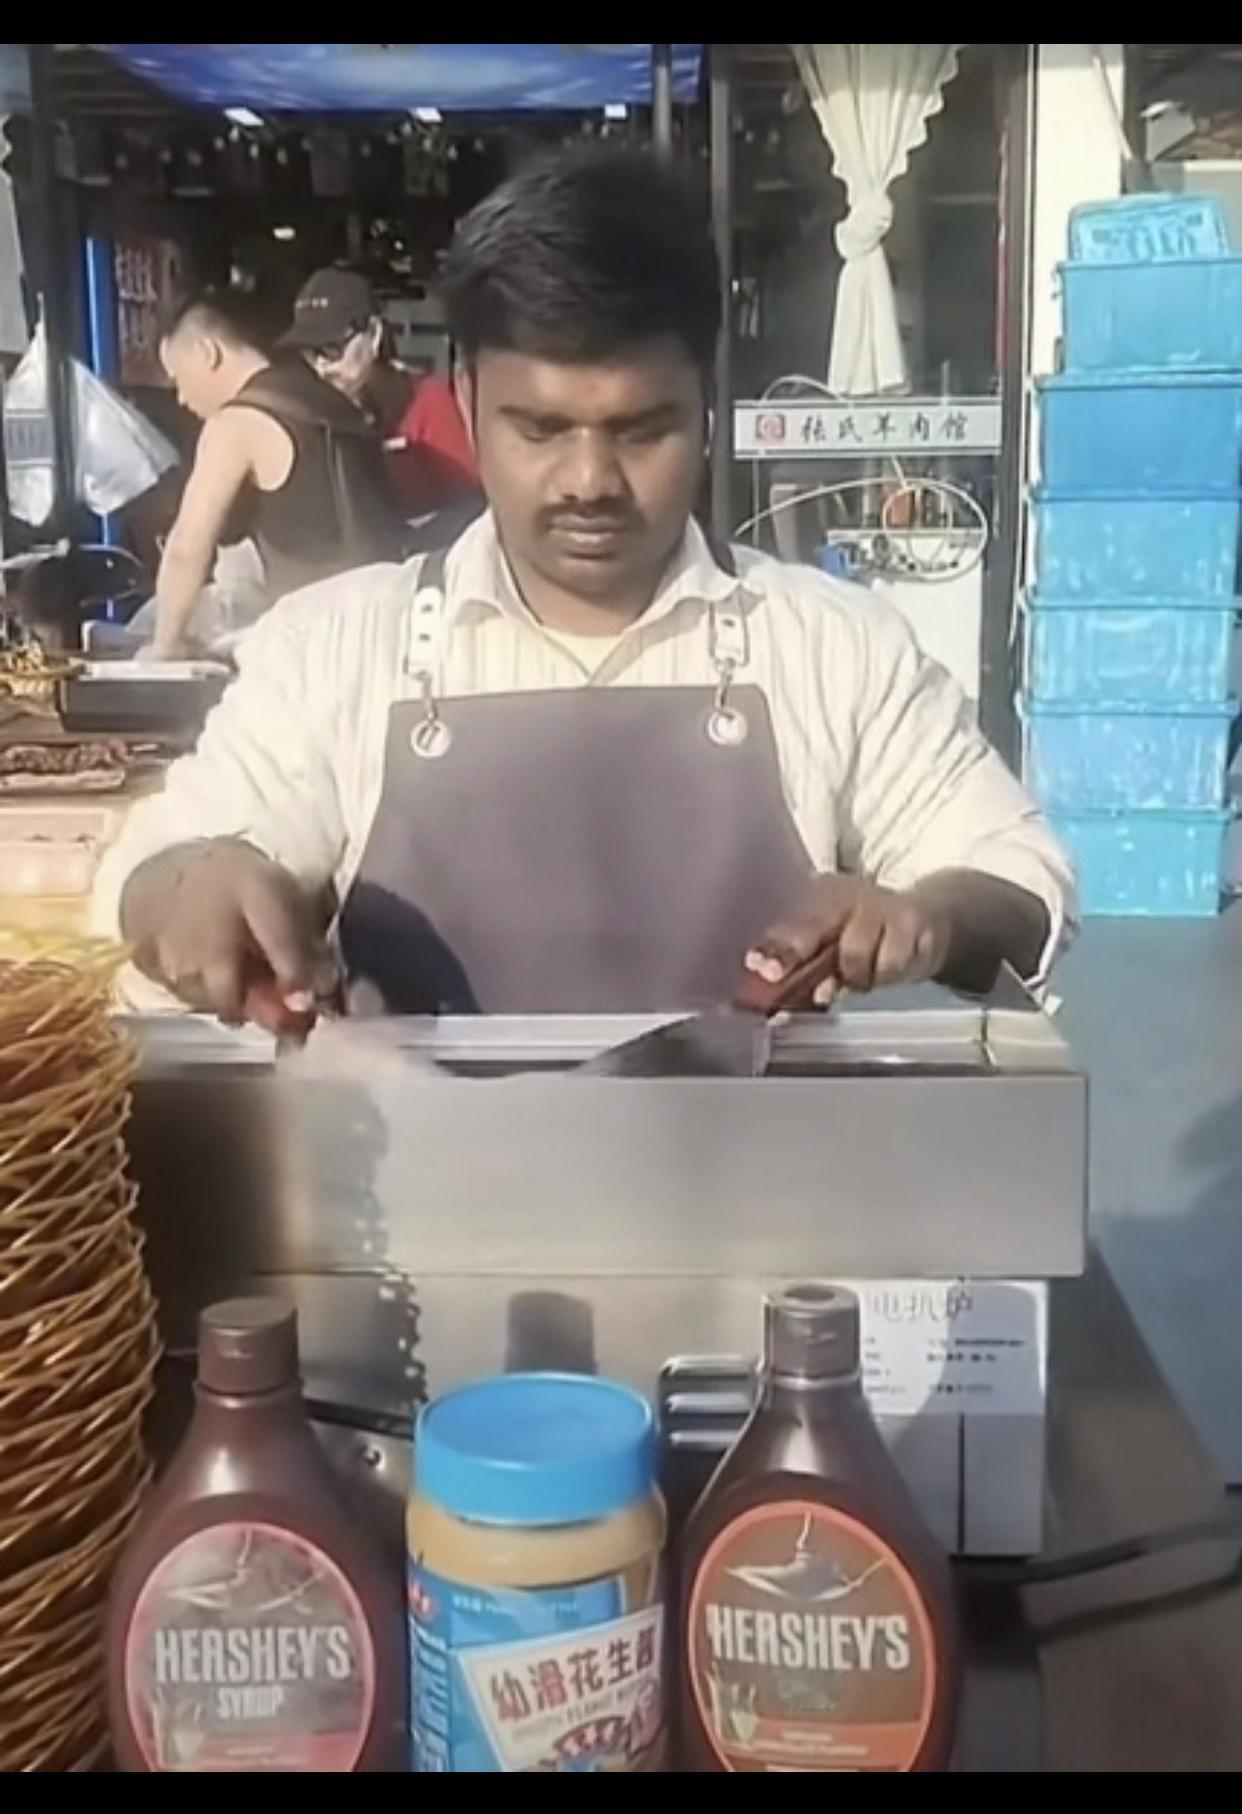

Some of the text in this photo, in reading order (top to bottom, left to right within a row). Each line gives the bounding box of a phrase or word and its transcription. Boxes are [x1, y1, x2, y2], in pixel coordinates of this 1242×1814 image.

[155, 1626, 352, 1683] HERSHEY'S
[706, 1602, 910, 1671] HERSHEY'S
[217, 1685, 284, 1719] SYRUP
